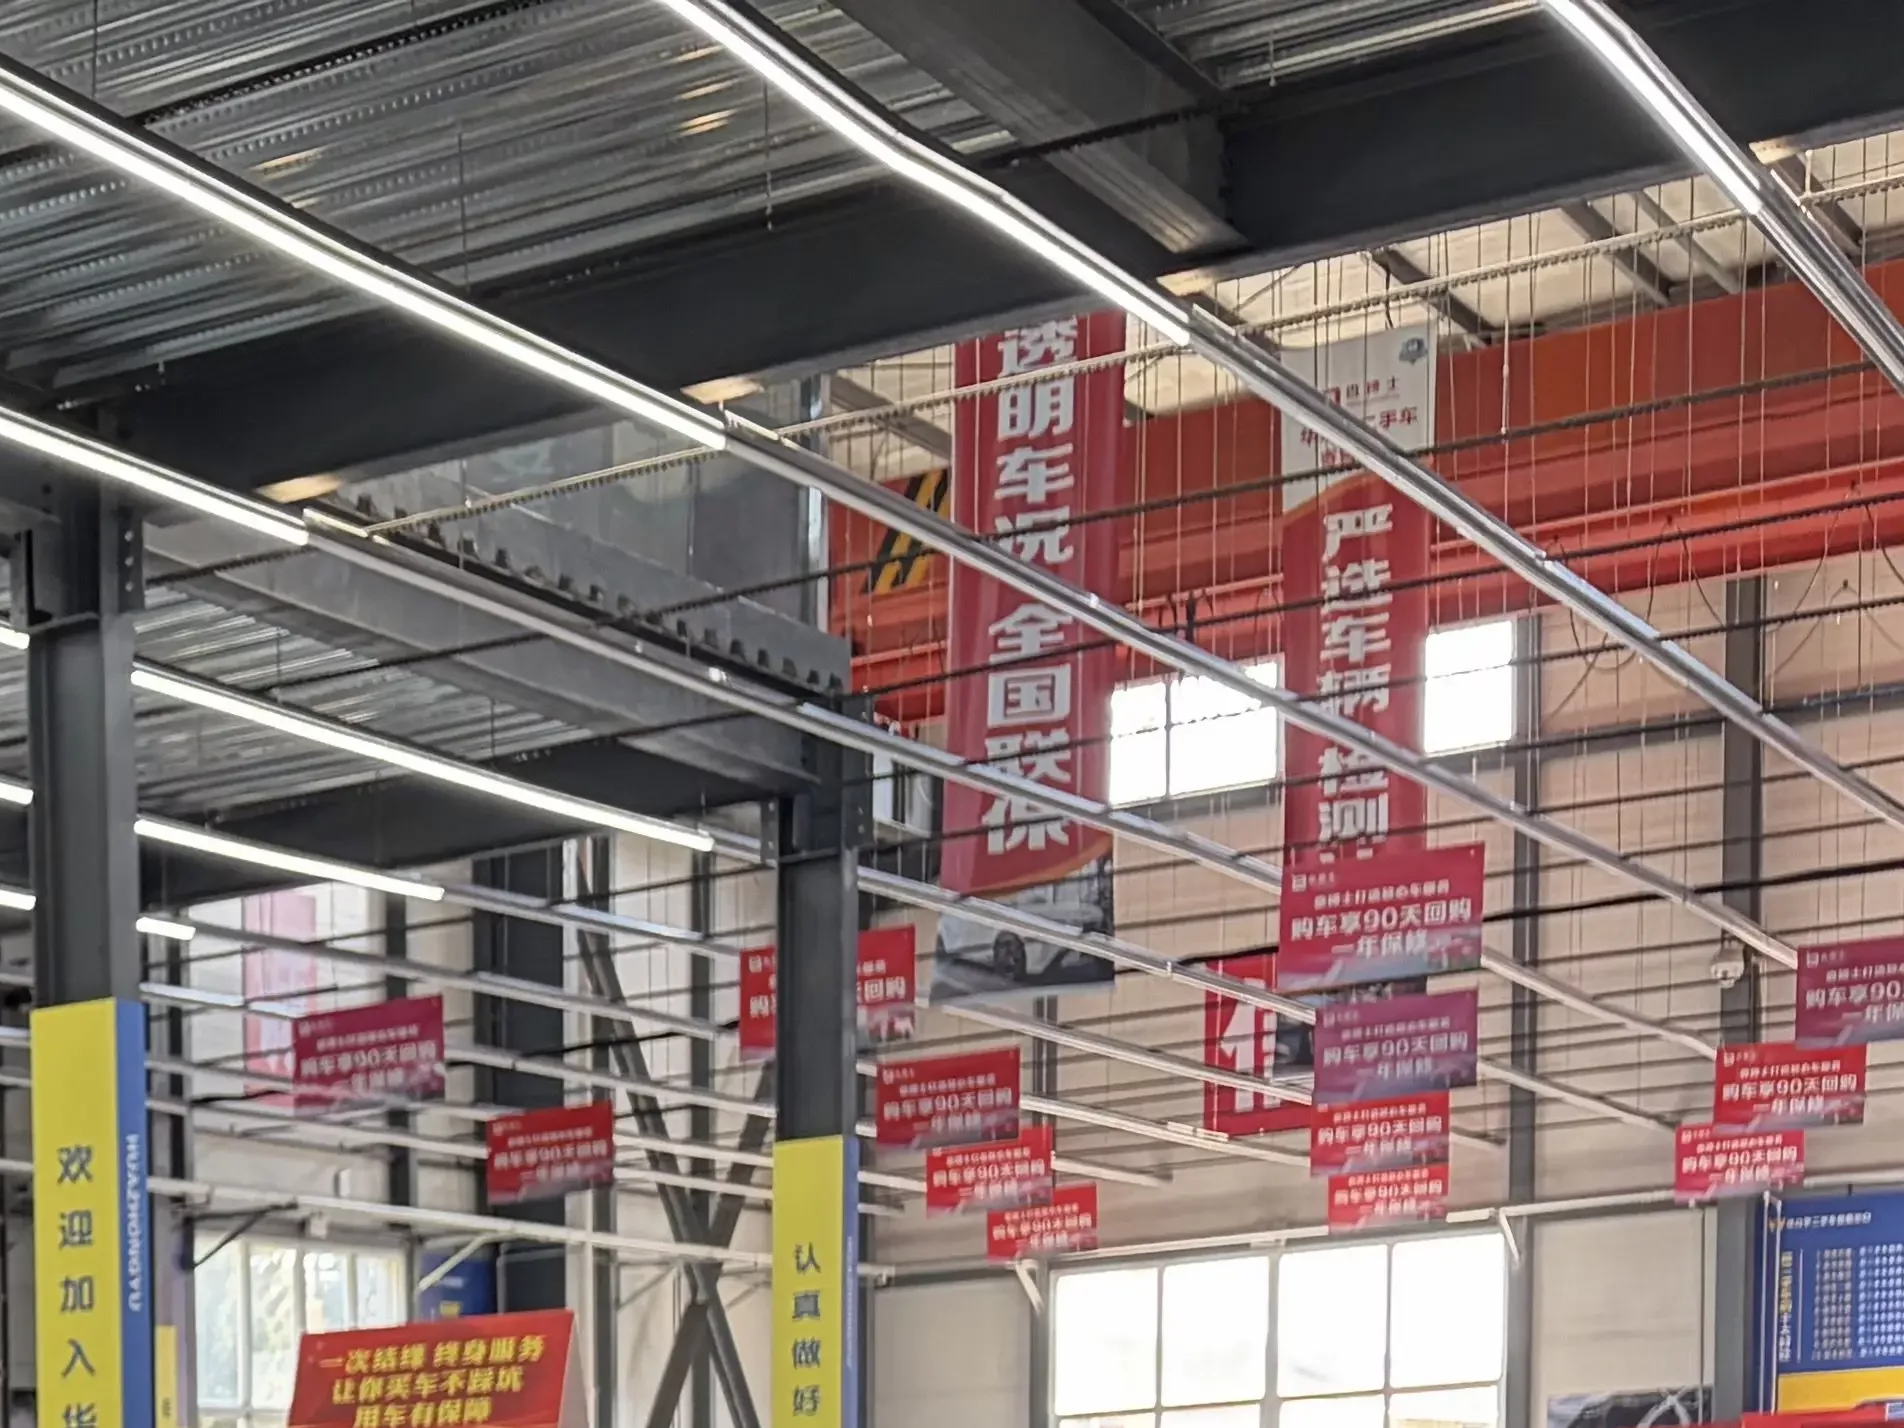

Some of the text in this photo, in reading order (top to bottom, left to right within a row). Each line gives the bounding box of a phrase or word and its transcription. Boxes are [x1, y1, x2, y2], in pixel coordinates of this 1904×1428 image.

[985, 316, 1078, 852] 透明车况 全国联保
[1292, 897, 1472, 940] 购车享90天回购
[1806, 980, 1904, 1009] 购车享90
[319, 1334, 547, 1374] 一次结缘 终身服务
[332, 1365, 525, 1405] 让你买车不踩坑
